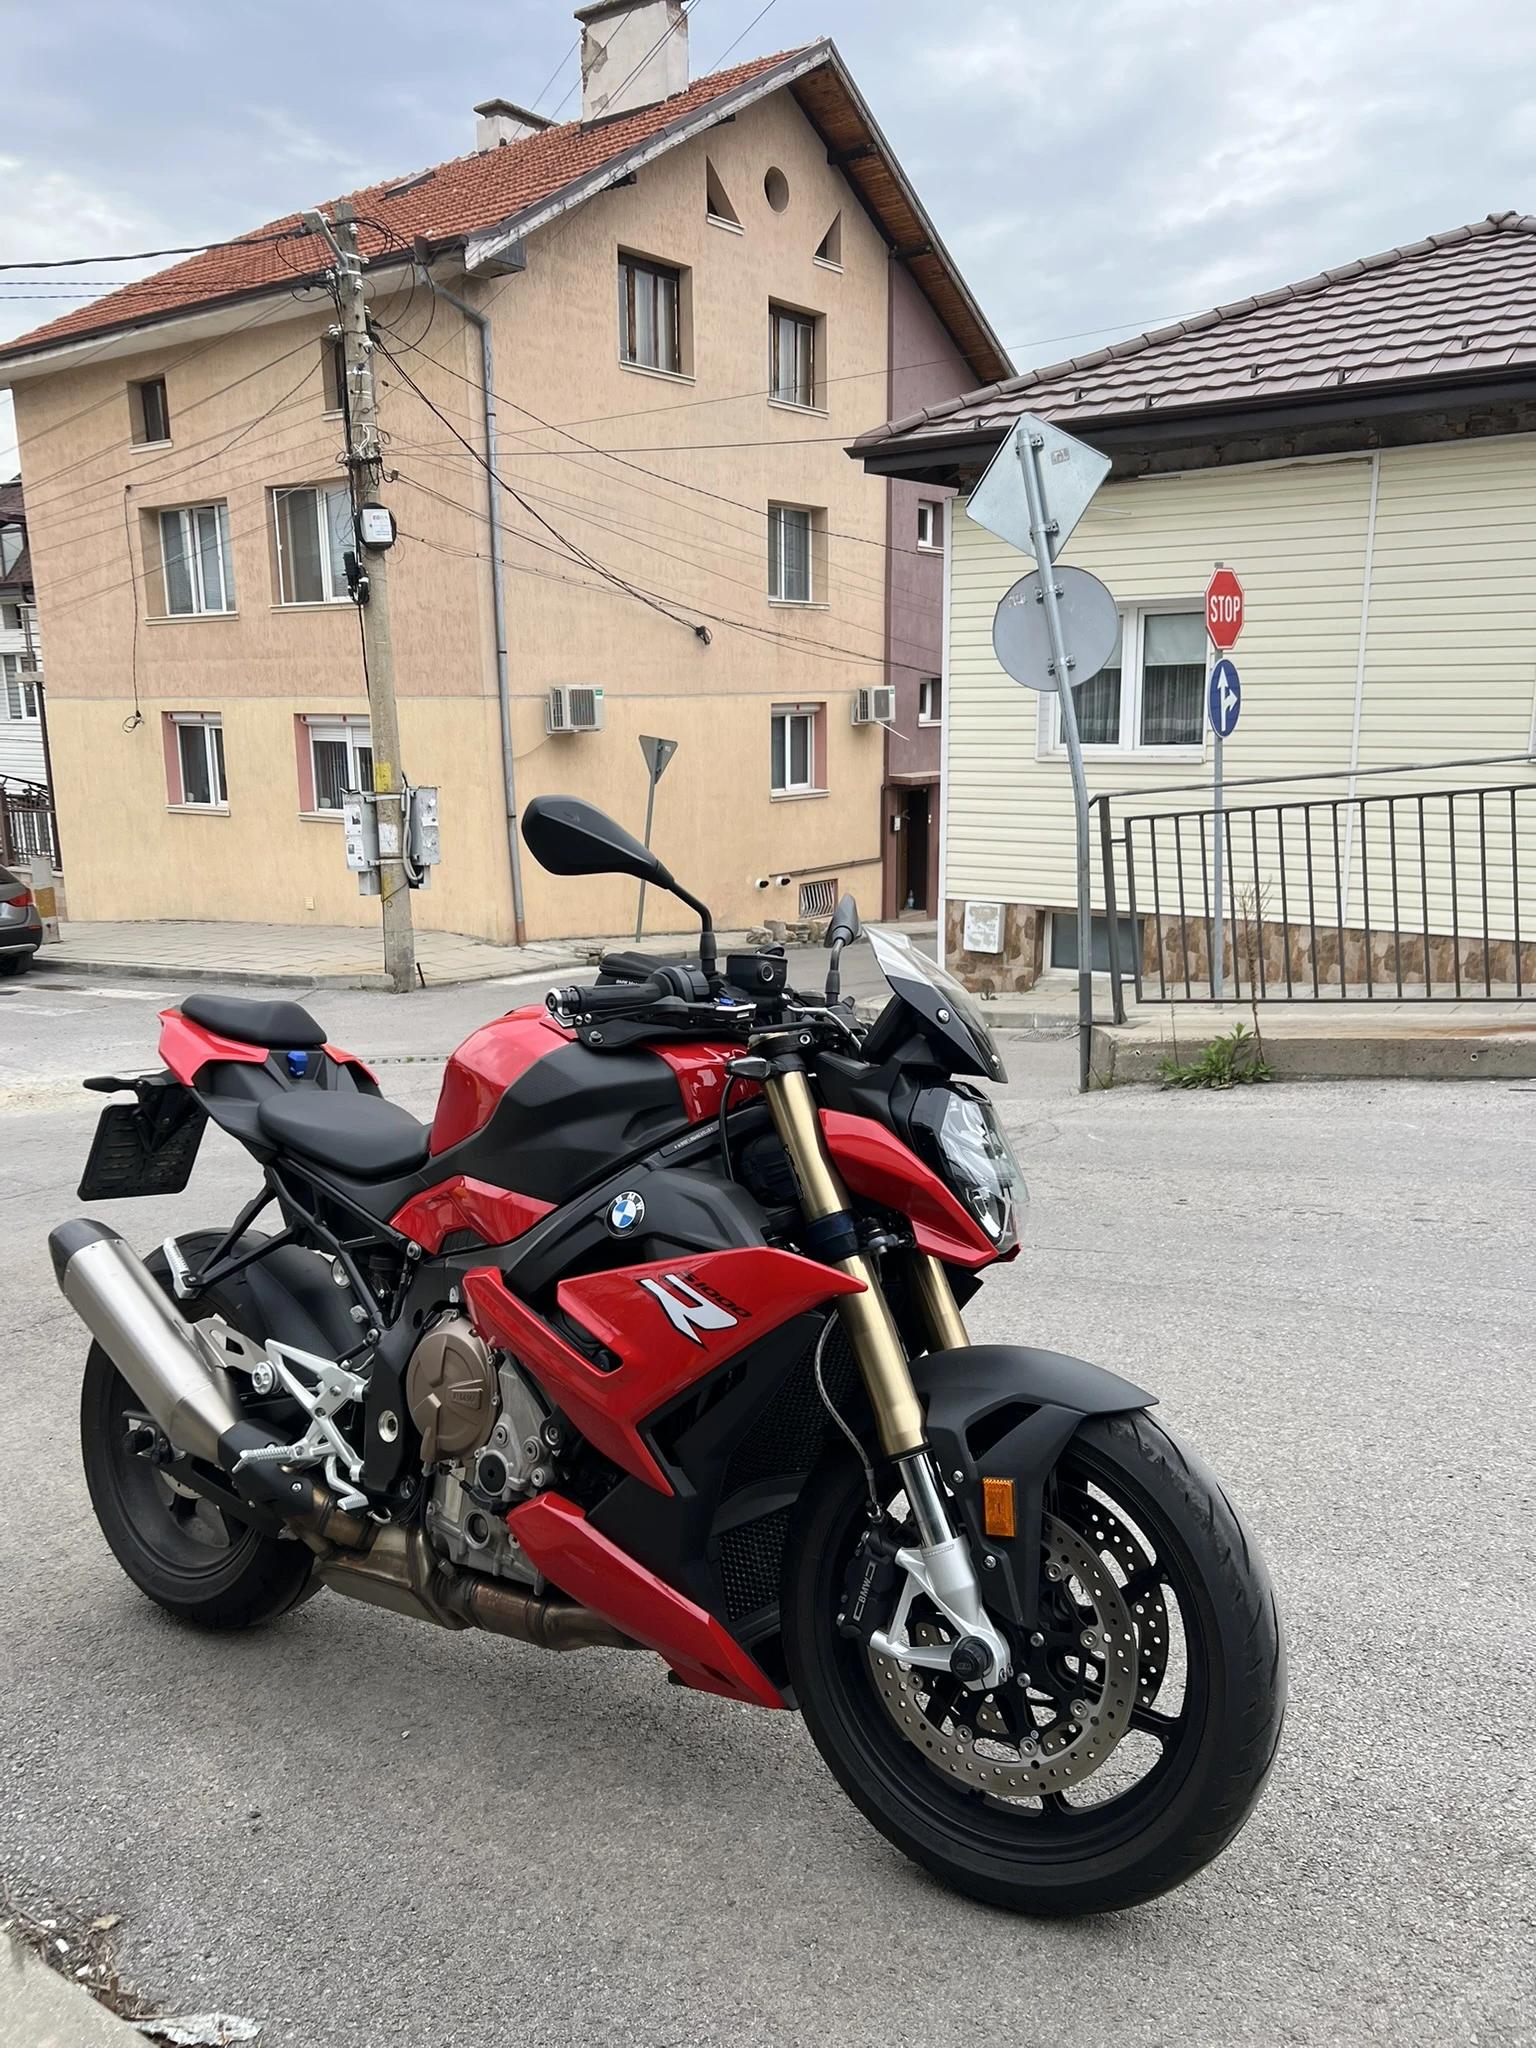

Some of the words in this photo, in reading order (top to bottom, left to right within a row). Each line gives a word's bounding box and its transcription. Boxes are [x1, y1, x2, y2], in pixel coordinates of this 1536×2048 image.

[1210, 595, 1241, 623] STOP
[614, 1191, 645, 1211] BMW
[452, 1391, 477, 1404] BMW
[858, 1576, 872, 1604] BMW
